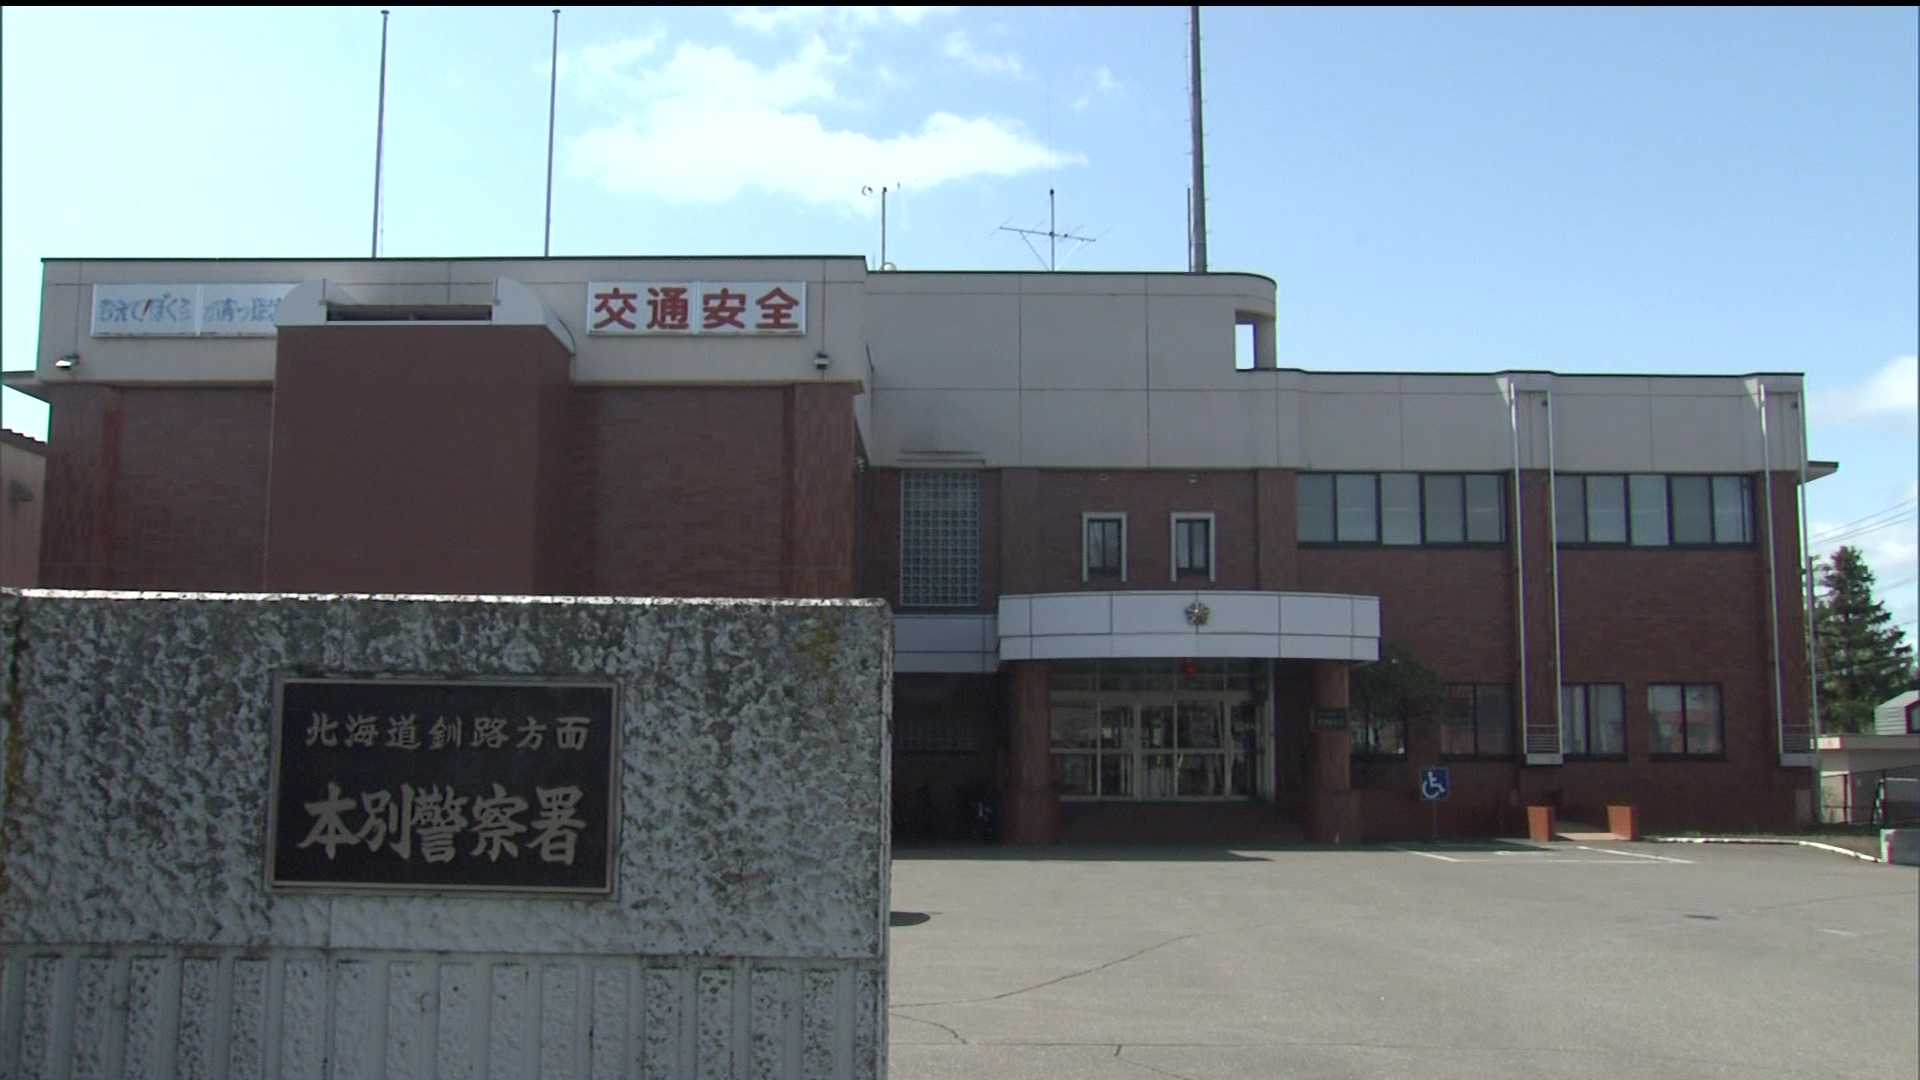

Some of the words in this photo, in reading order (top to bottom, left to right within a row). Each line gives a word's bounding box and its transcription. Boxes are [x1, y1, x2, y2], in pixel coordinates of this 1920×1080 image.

[593, 287, 799, 329] 交通安全
[306, 712, 590, 751] 北海道釧路方面
[298, 783, 587, 866] 本別警察署
